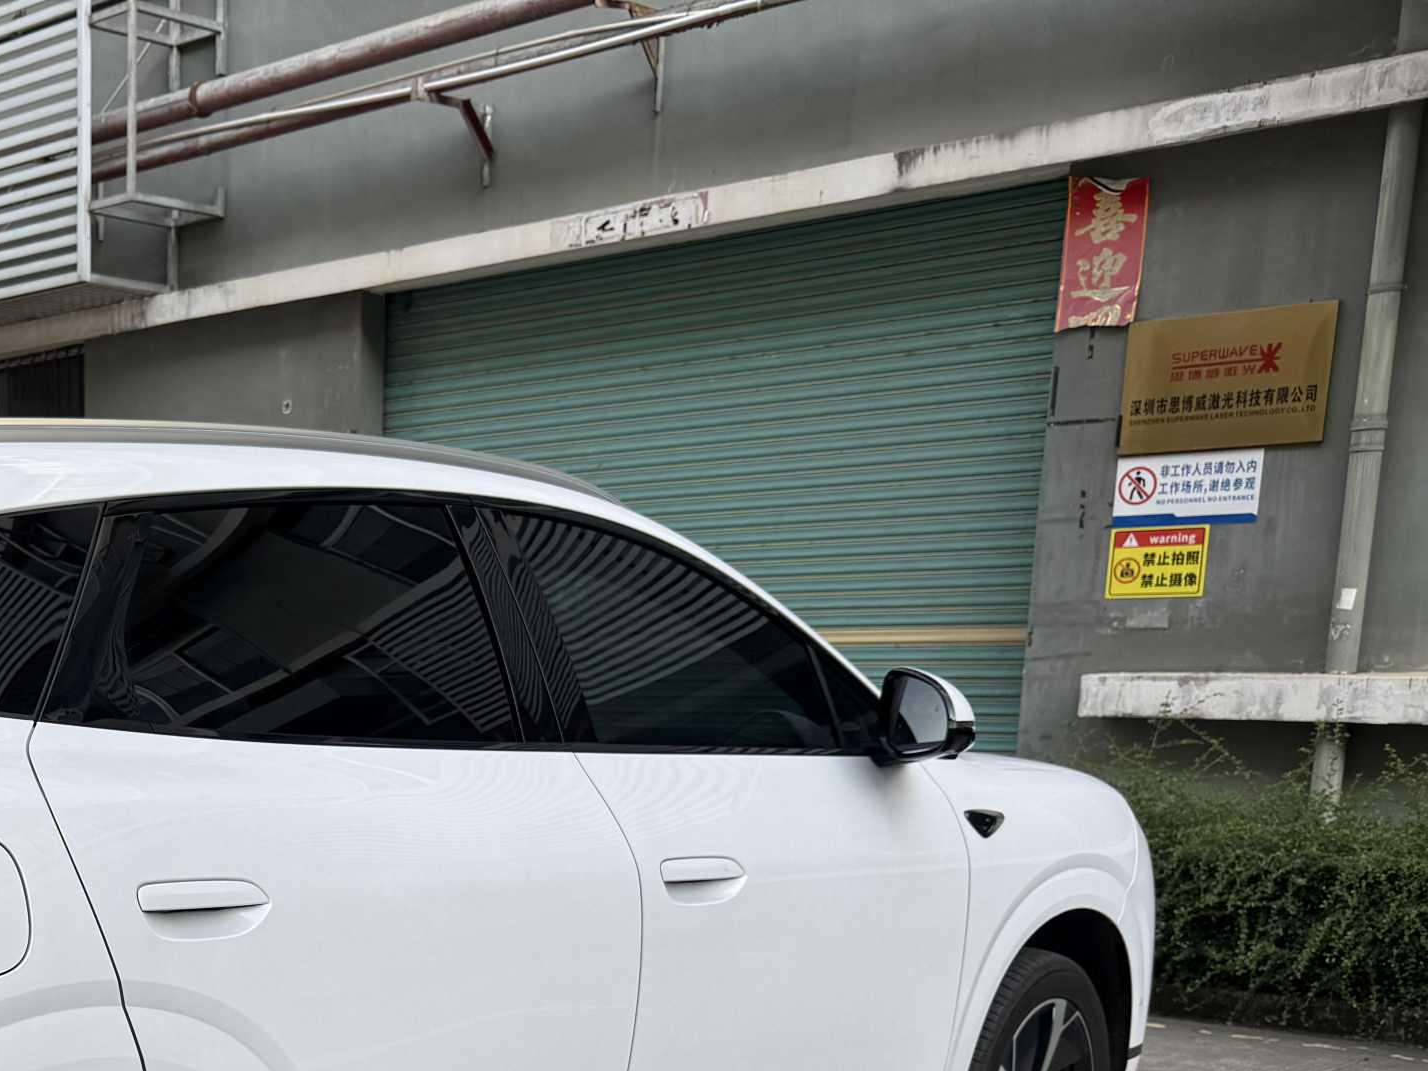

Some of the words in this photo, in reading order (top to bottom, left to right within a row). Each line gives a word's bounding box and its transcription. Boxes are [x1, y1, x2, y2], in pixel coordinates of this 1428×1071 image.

[1172, 344, 1258, 364] SUPERWAVE
[1130, 384, 1318, 417] 深圳市思博威激光科技有限公司
[1160, 460, 1257, 478] 非工作人员请勿入内
[1149, 532, 1196, 545] warning
[1143, 550, 1200, 567] 禁止拍照
[1140, 572, 1197, 588] 禁止摄像
